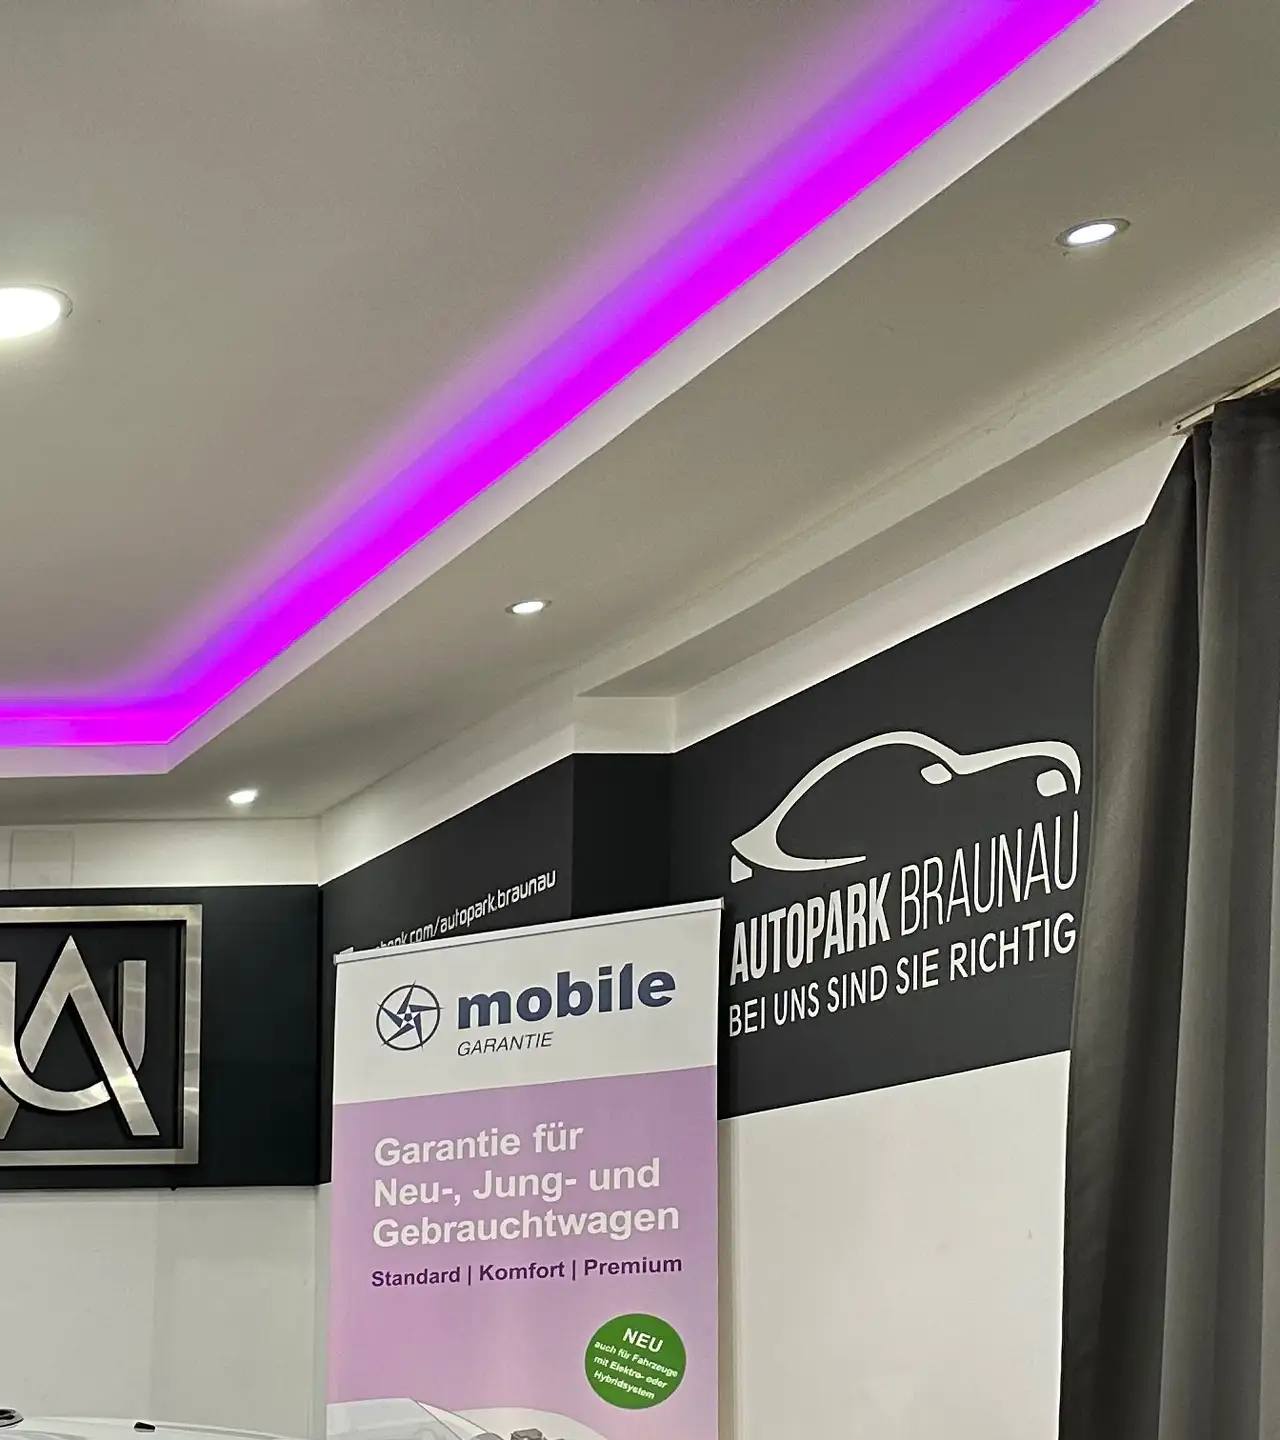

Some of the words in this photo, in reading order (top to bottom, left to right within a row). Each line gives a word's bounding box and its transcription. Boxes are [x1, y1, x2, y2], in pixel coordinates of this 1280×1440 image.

[729, 871, 892, 986] AUTOPARK
[900, 810, 1079, 937] BRAUNAU
[729, 996, 766, 1037] BEI
[773, 982, 820, 1026] UNS
[827, 964, 888, 1013] SIND
[895, 948, 940, 995] SIE
[949, 912, 1077, 982] RICHTIG
[457, 962, 676, 1030] mobile
[456, 1031, 554, 1057] GARANTIE
[375, 1127, 521, 1166] Garantie
[533, 1121, 584, 1153] für
[374, 1178, 461, 1207] Neu-,
[472, 1170, 577, 1203] Jung-
[589, 1158, 660, 1191] und
[373, 1206, 679, 1248] Gebrauchtwagen
[371, 1266, 461, 1287] Standard
[479, 1260, 565, 1281] Komfort
[584, 1256, 683, 1276] Premium
[593, 1341, 617, 1355] auch
[617, 1348, 632, 1360] für
[631, 1353, 678, 1378] Fahrzeuge
[622, 1327, 664, 1353] NEU
[593, 1356, 610, 1368] mit
[645, 1376, 668, 1389] oder
[593, 1370, 655, 1400] Hybridsystem
